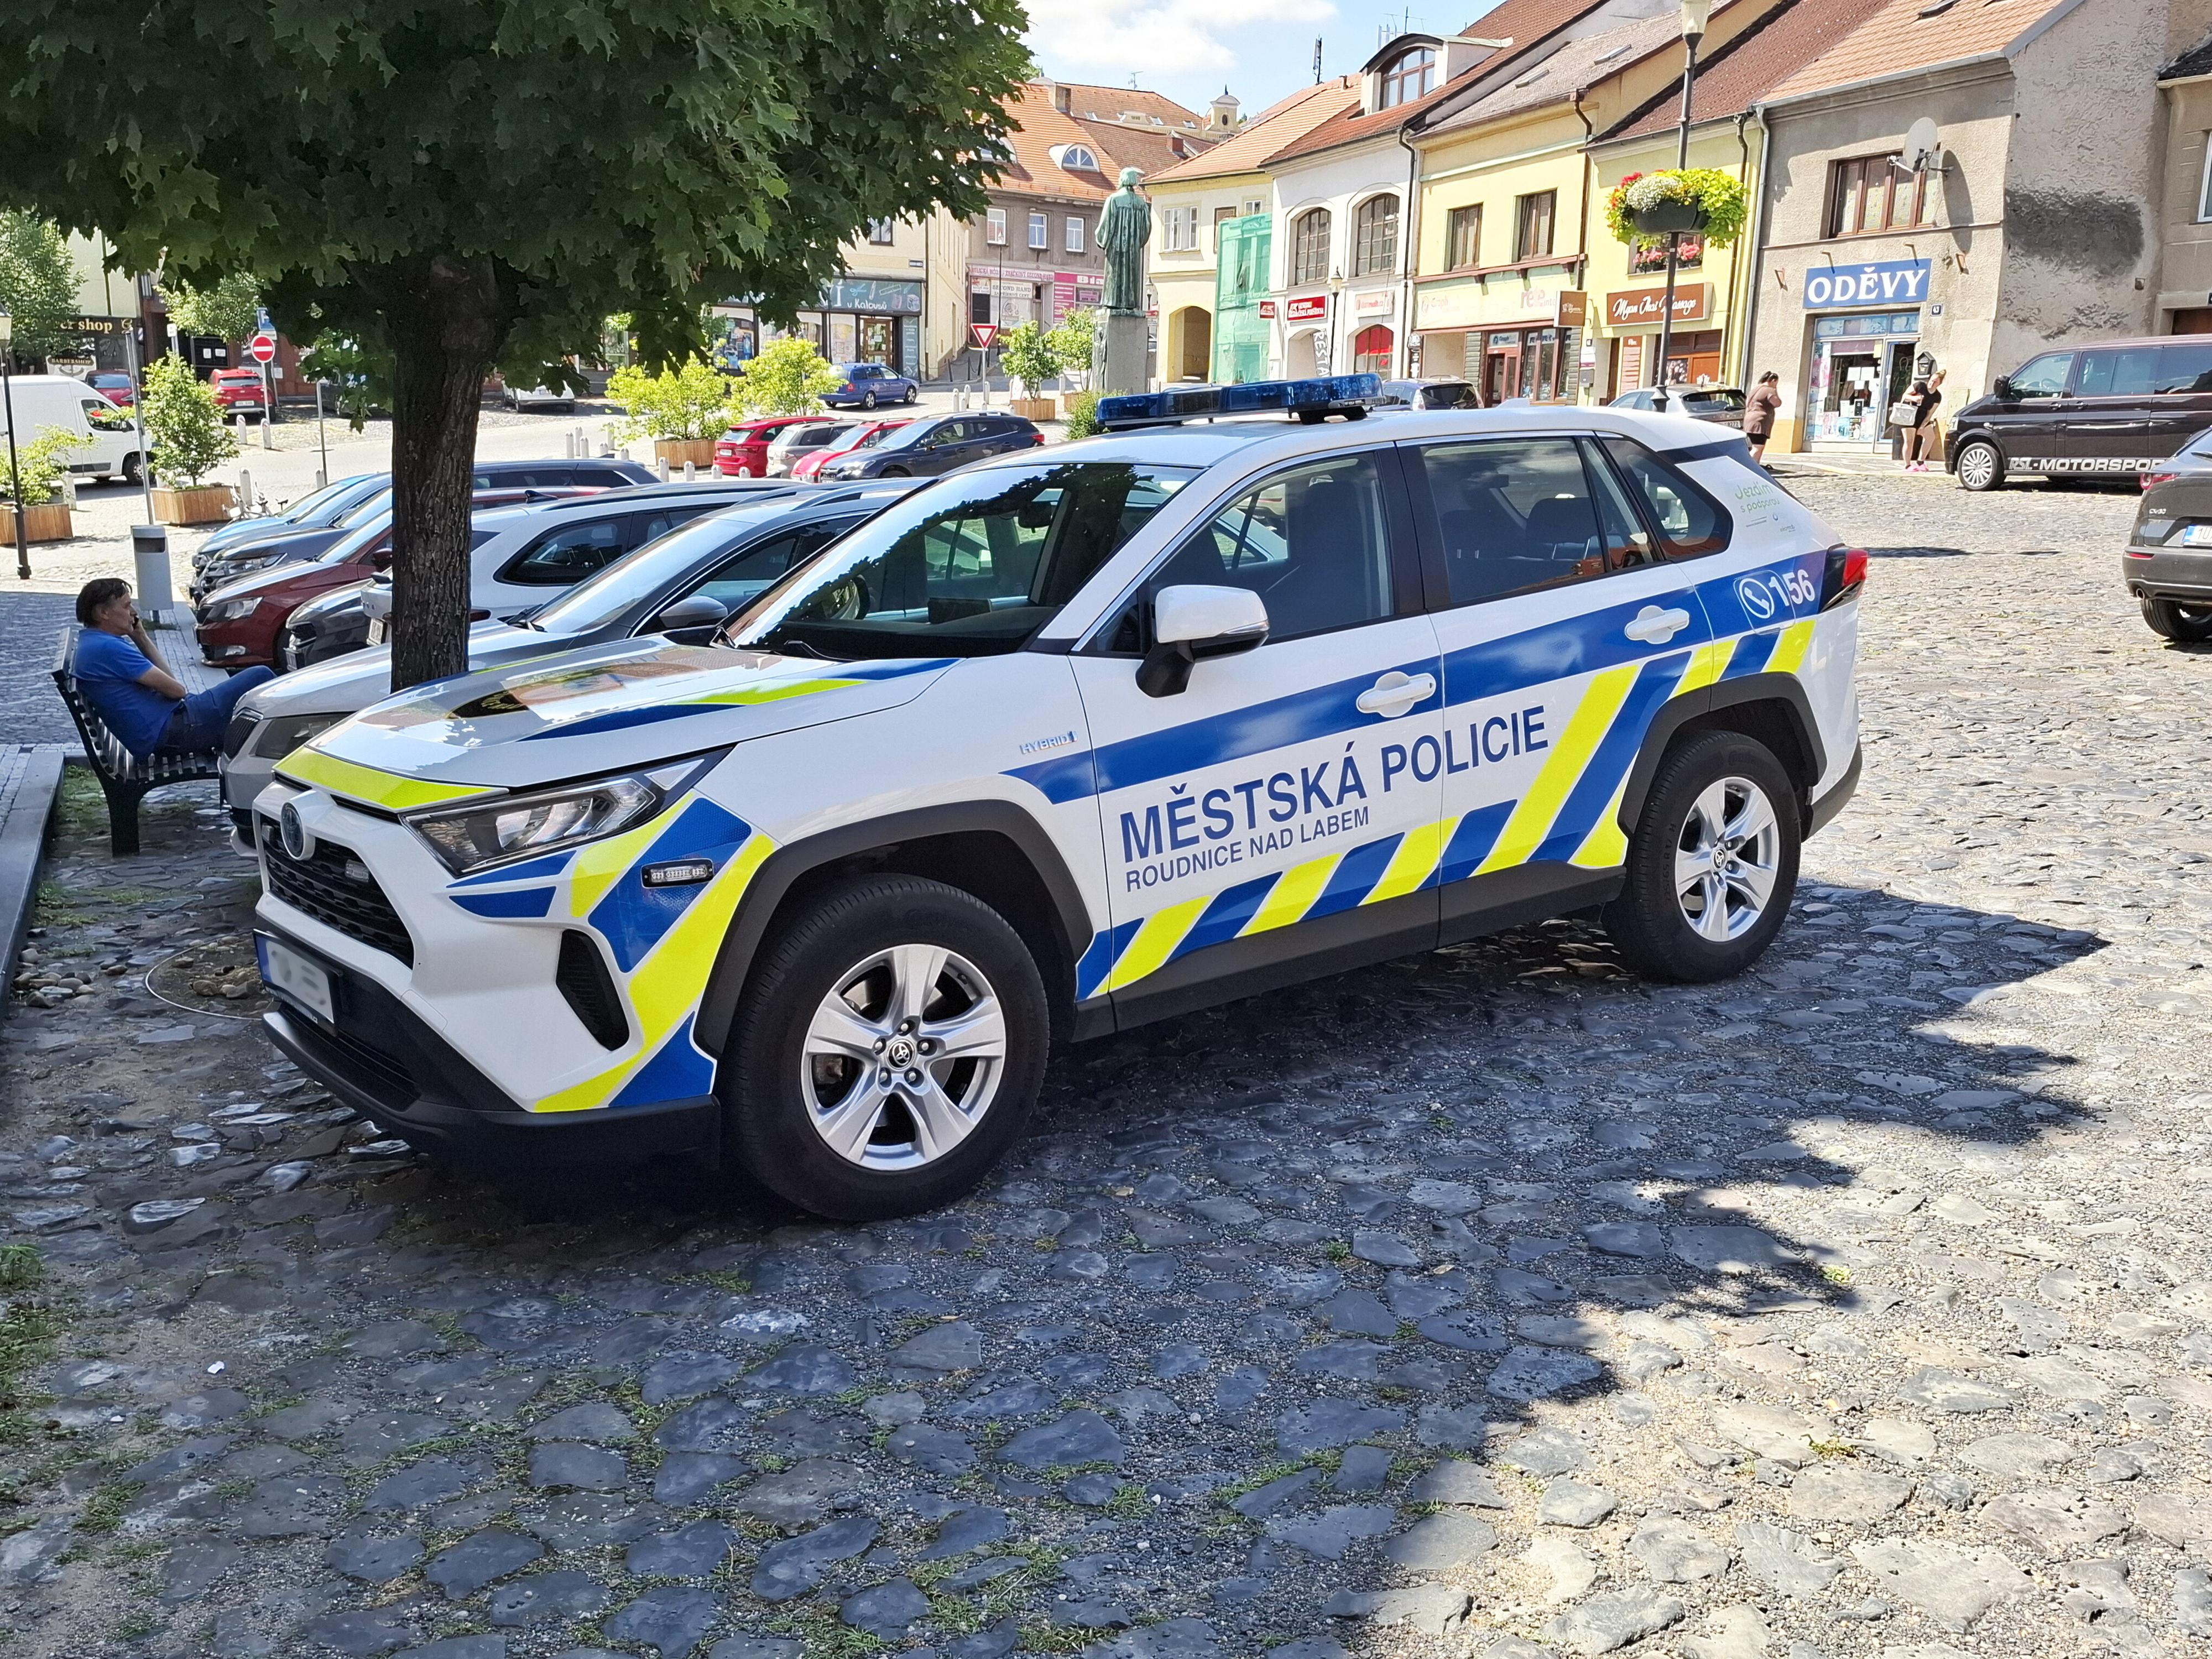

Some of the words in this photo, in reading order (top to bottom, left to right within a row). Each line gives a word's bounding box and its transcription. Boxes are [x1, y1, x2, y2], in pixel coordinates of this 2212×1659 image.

[1808, 267, 1927, 303] ODĚVY
[78, 318, 113, 333] shop
[1313, 332, 1331, 377] RESTA
[1735, 481, 1774, 499] Jezdím
[2198, 526, 2212, 540] 1U
[1768, 569, 1815, 606] 156
[1019, 734, 1068, 754] HYBRID
[1120, 740, 1367, 863] MĚSTSKÁ
[1381, 705, 1548, 792] POLICIE
[1126, 841, 1243, 892] ROUDNICE
[1250, 827, 1293, 857] NAD
[1301, 806, 1369, 843] LABEM
